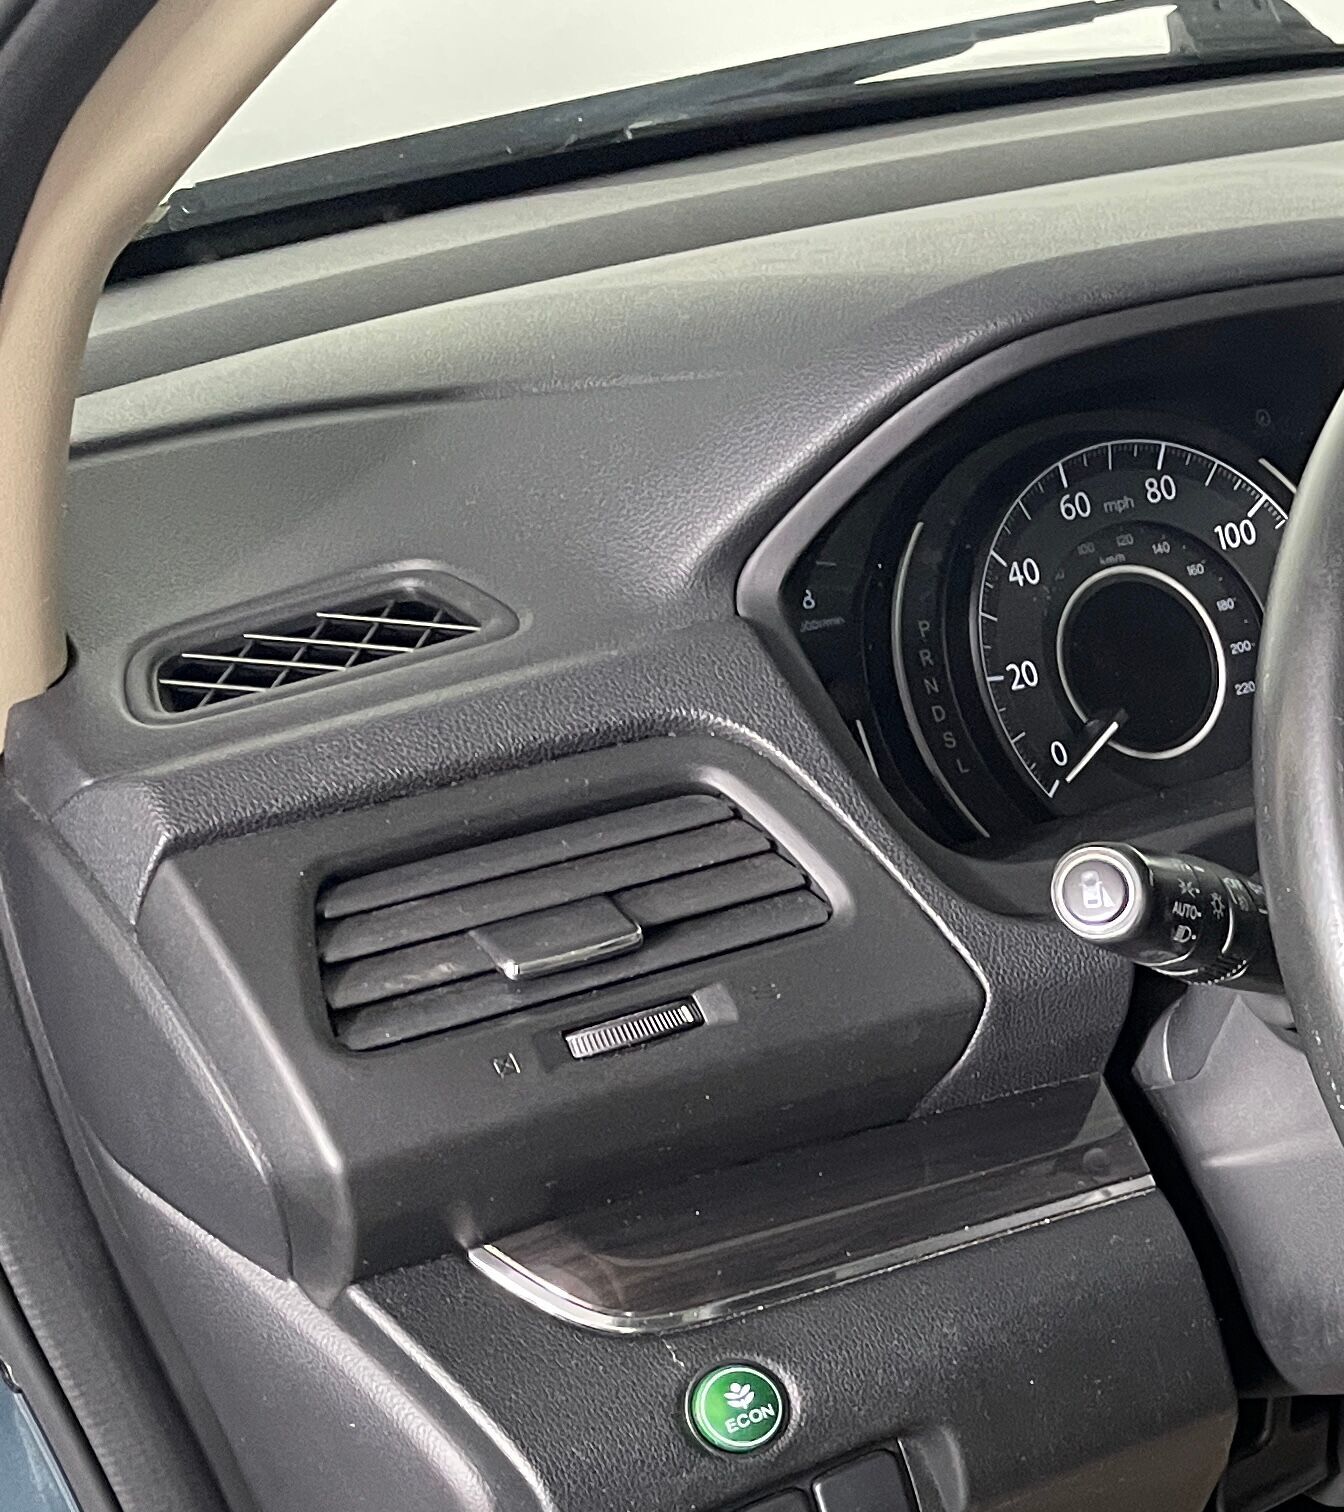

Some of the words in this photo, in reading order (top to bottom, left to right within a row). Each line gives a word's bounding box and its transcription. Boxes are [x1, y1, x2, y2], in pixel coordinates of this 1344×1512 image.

[1144, 474, 1176, 504] 80
[1059, 491, 1092, 521] 60
[1103, 496, 1135, 513] mph
[1214, 518, 1257, 550] 100
[1151, 541, 1171, 555] 140
[1007, 557, 1041, 587] 40
[1215, 598, 1235, 612] 180
[917, 620, 930, 638] P
[1230, 641, 1252, 655] 200
[919, 649, 935, 668] R
[1005, 659, 1039, 691] 20
[924, 677, 940, 695] N
[1234, 680, 1256, 695] 220
[931, 704, 946, 723] D
[942, 731, 957, 750] S
[1050, 740, 1068, 766] 0
[956, 758, 971, 775] L
[1172, 901, 1198, 919] AUTO
[724, 1403, 776, 1434] ECON
